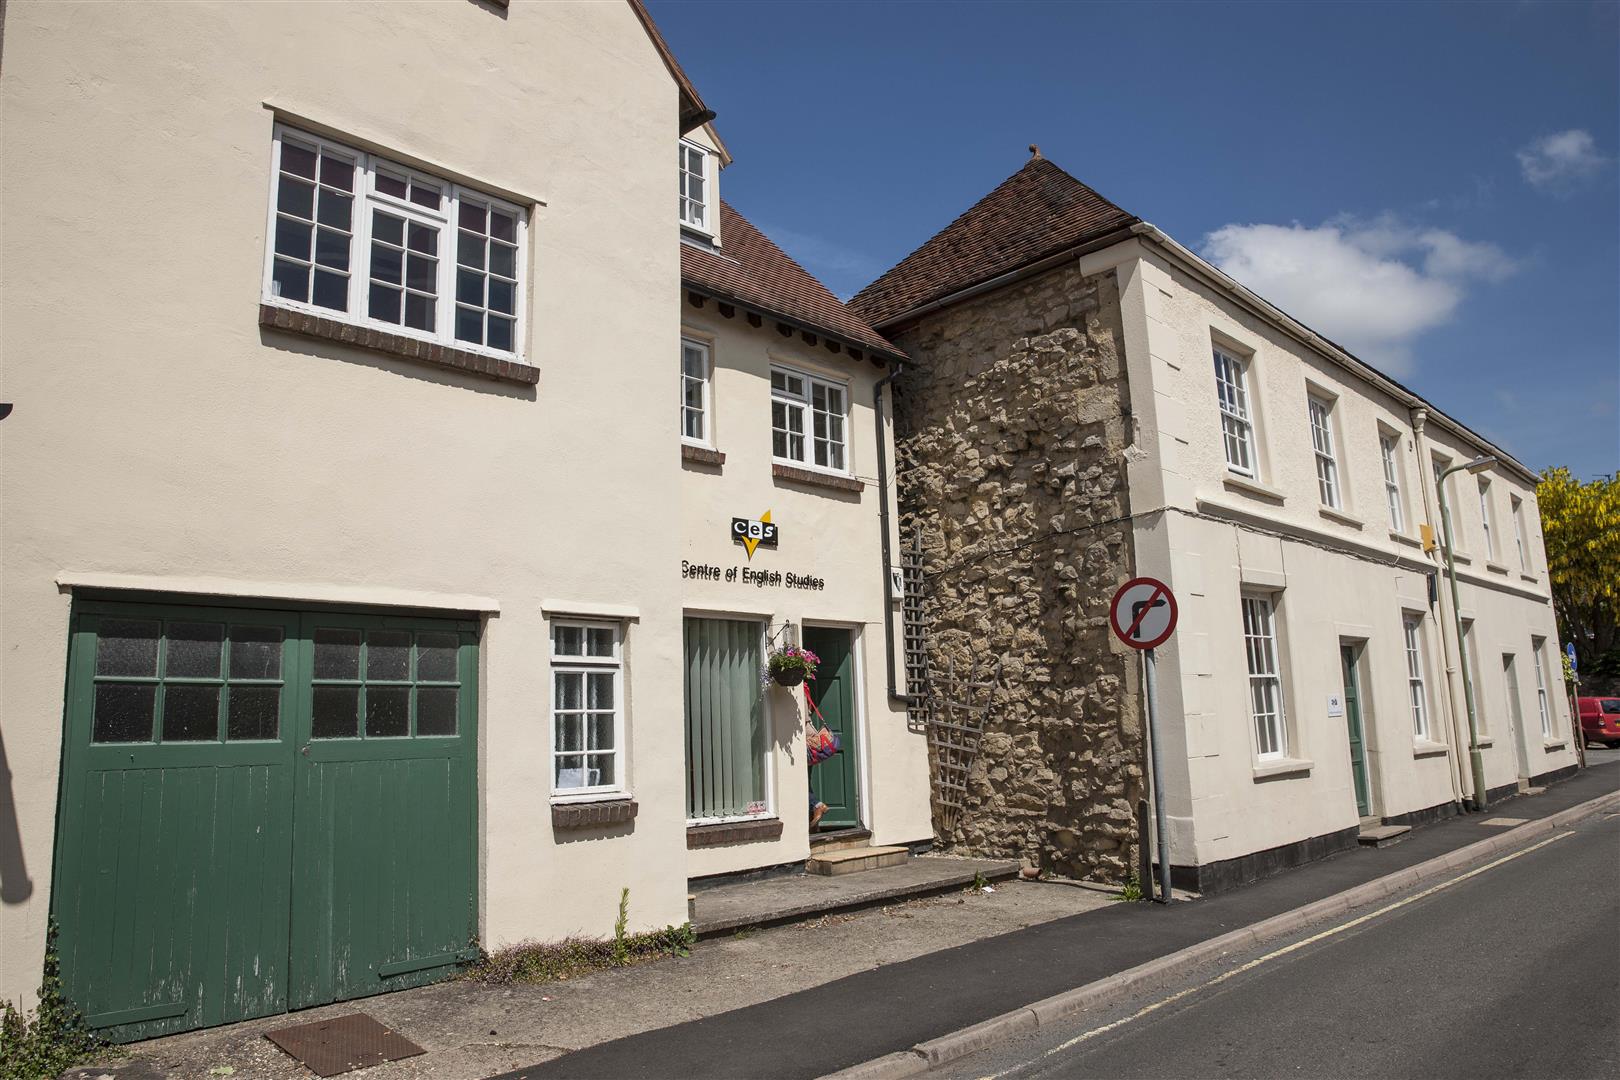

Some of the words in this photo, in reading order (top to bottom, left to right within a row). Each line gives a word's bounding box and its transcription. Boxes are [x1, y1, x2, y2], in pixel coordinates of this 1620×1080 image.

[682, 560, 721, 577] Centre
[726, 566, 738, 579] of
[743, 567, 782, 585] English
[786, 572, 825, 587] Studies
